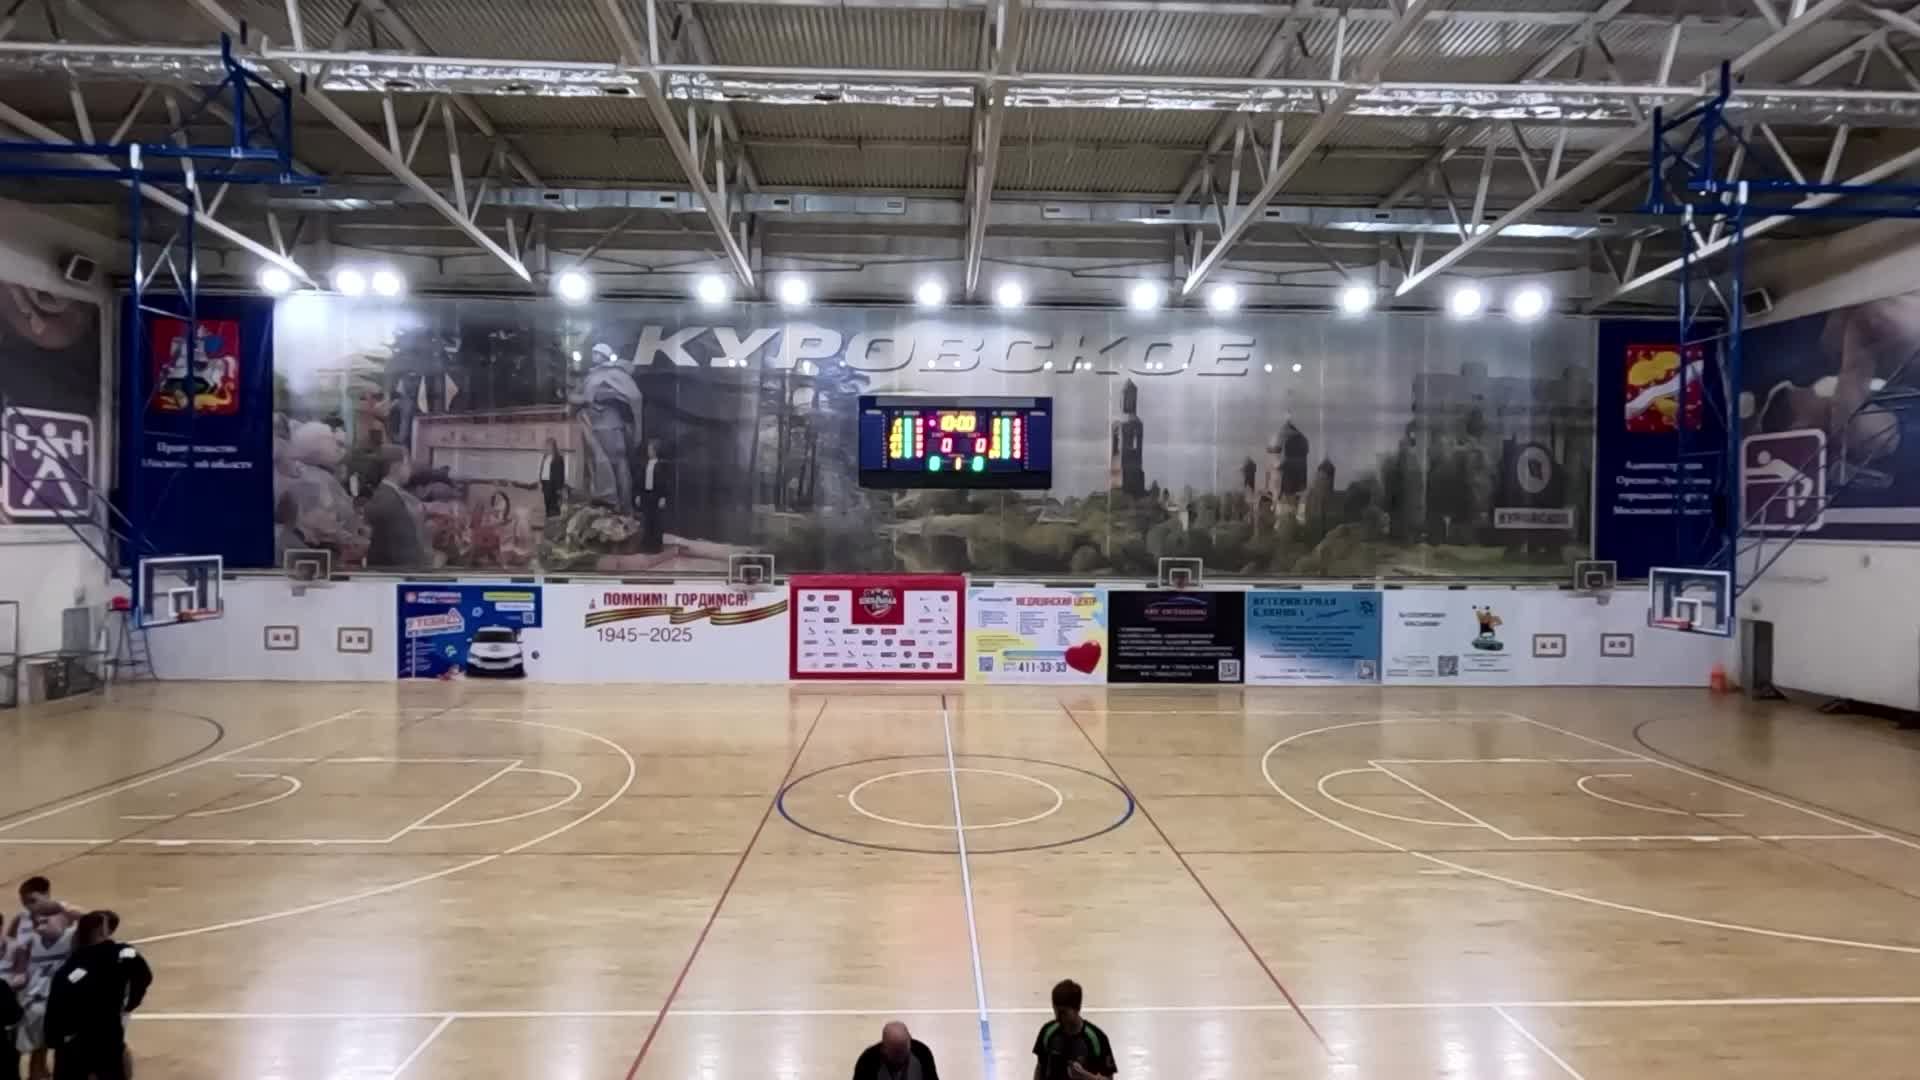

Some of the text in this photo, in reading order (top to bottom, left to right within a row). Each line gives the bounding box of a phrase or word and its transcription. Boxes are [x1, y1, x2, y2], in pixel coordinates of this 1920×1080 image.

[632, 325, 1256, 377] КУРОВСКОЕ
[941, 437, 987, 453] 0 0
[603, 592, 748, 608] ПОМНИМ! ГОРДИМСЯ!
[1018, 661, 1067, 673] 411-33-33
